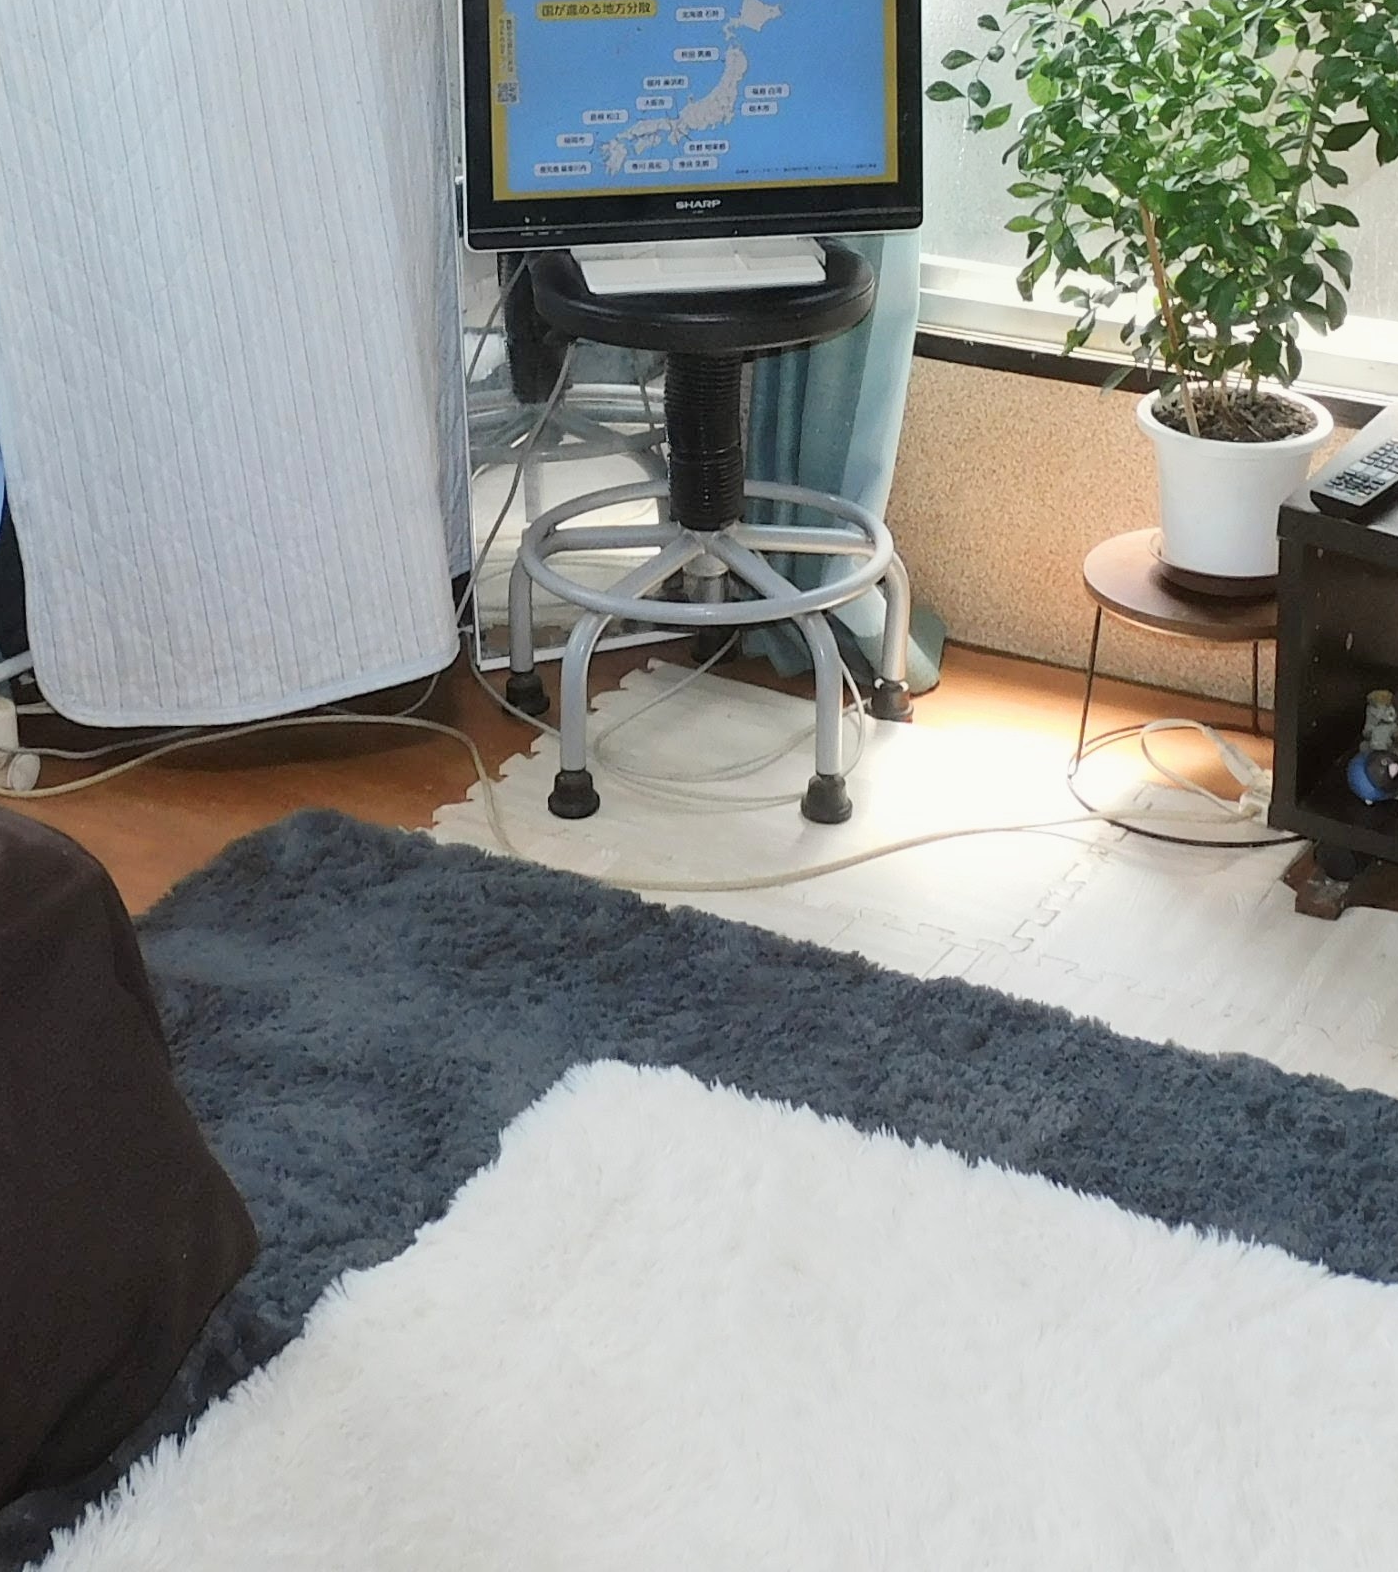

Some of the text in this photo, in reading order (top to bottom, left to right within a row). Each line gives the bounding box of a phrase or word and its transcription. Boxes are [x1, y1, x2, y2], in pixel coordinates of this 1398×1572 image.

[541, 1, 651, 17] 国が進める地方分散
[675, 199, 721, 210] SHARP
